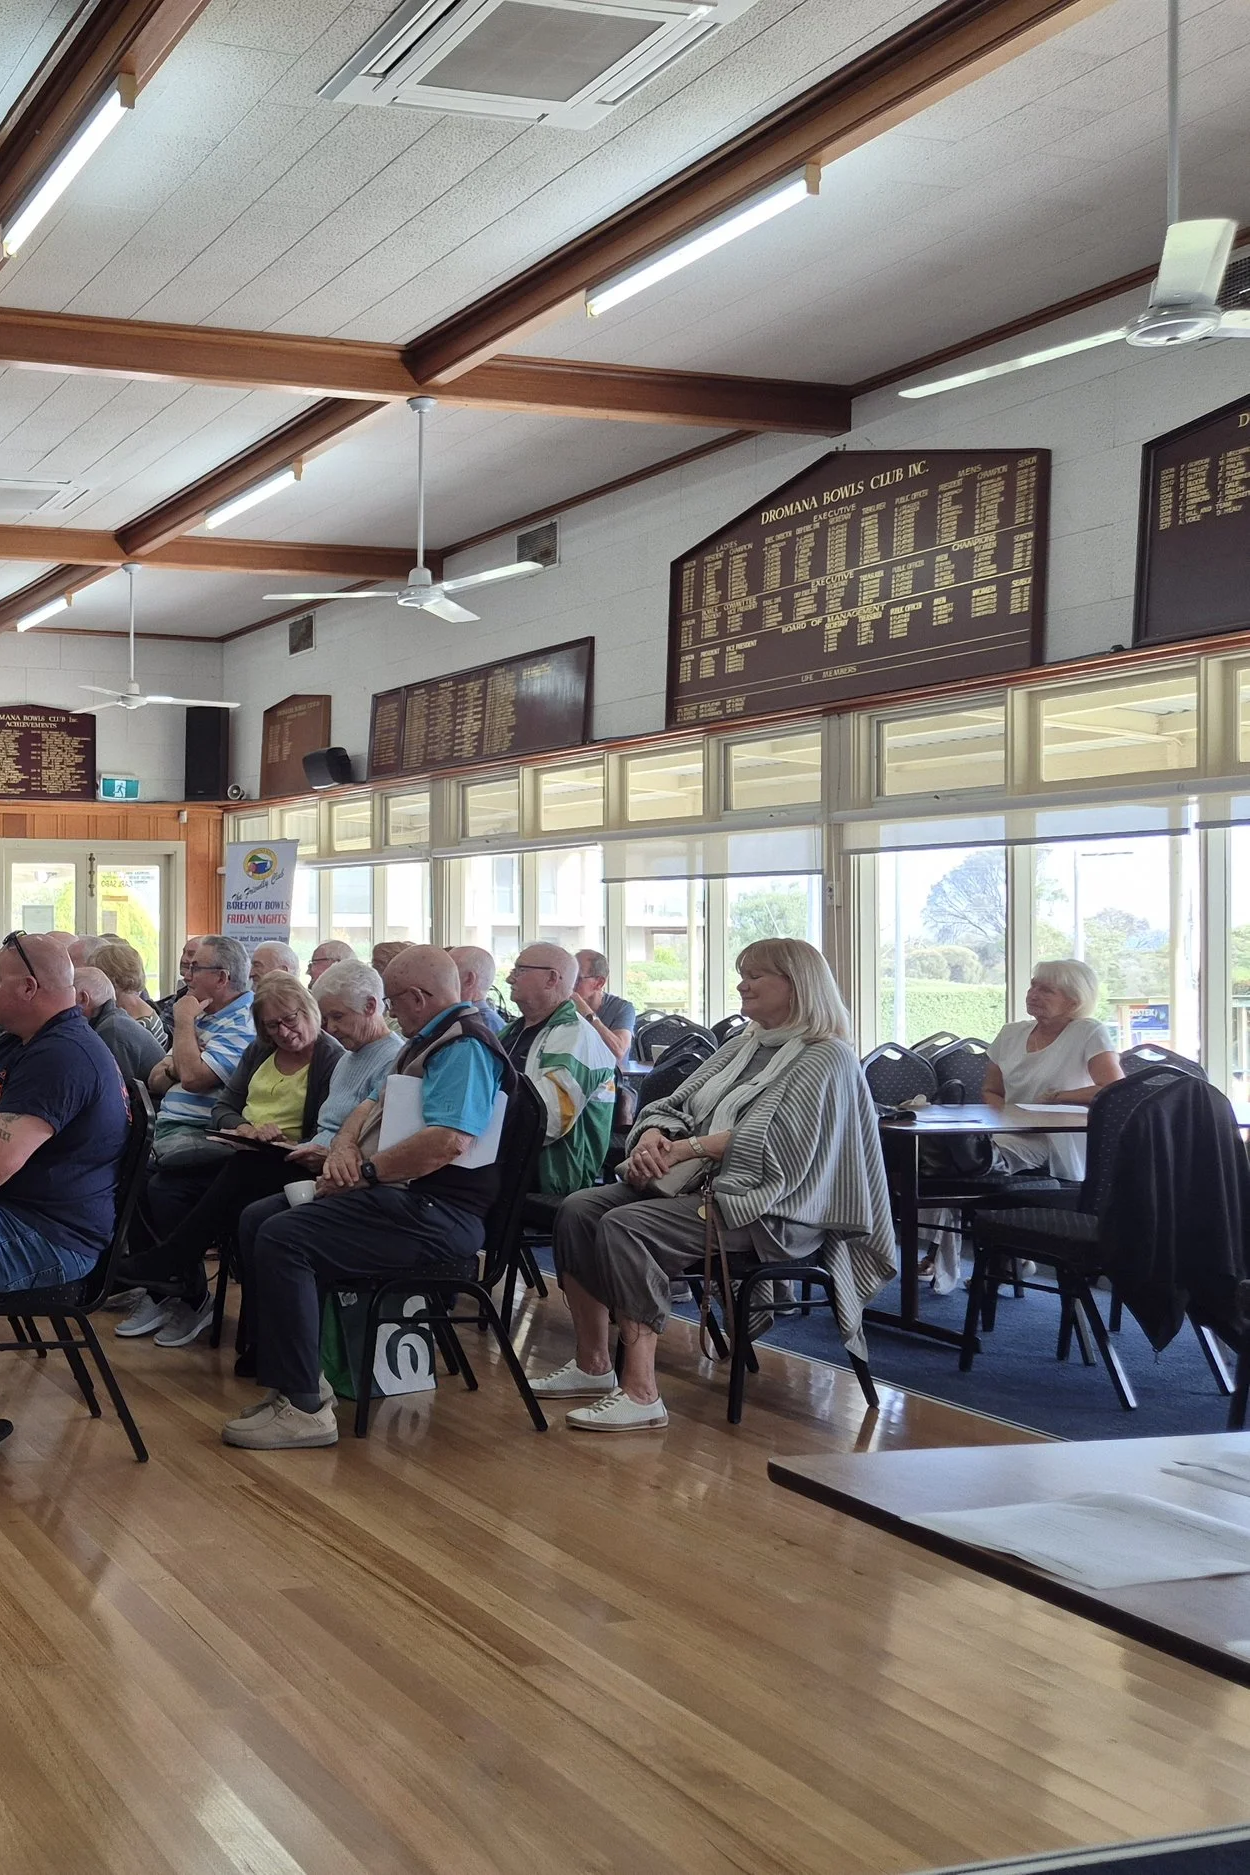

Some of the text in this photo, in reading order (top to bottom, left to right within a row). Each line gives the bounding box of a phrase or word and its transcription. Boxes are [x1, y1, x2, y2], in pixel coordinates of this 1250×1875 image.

[957, 465, 982, 478] MENS
[761, 460, 930, 525] DROMANA BOWLS CLUB INC.
[813, 503, 857, 523] EXECUTIVE
[715, 540, 738, 553] LADIES
[951, 533, 997, 551] CHAMPIONS
[811, 570, 854, 588] EXECUTIVE
[782, 603, 886, 634] BOARD OF MANAGEMENT
[5, 721, 58, 729] ACHIEVEMENTS
[244, 880, 269, 899] Friendly
[226, 900, 291, 911] BAREFOOT BOWLS
[227, 914, 288, 925] FRIDAY NIGHTS
